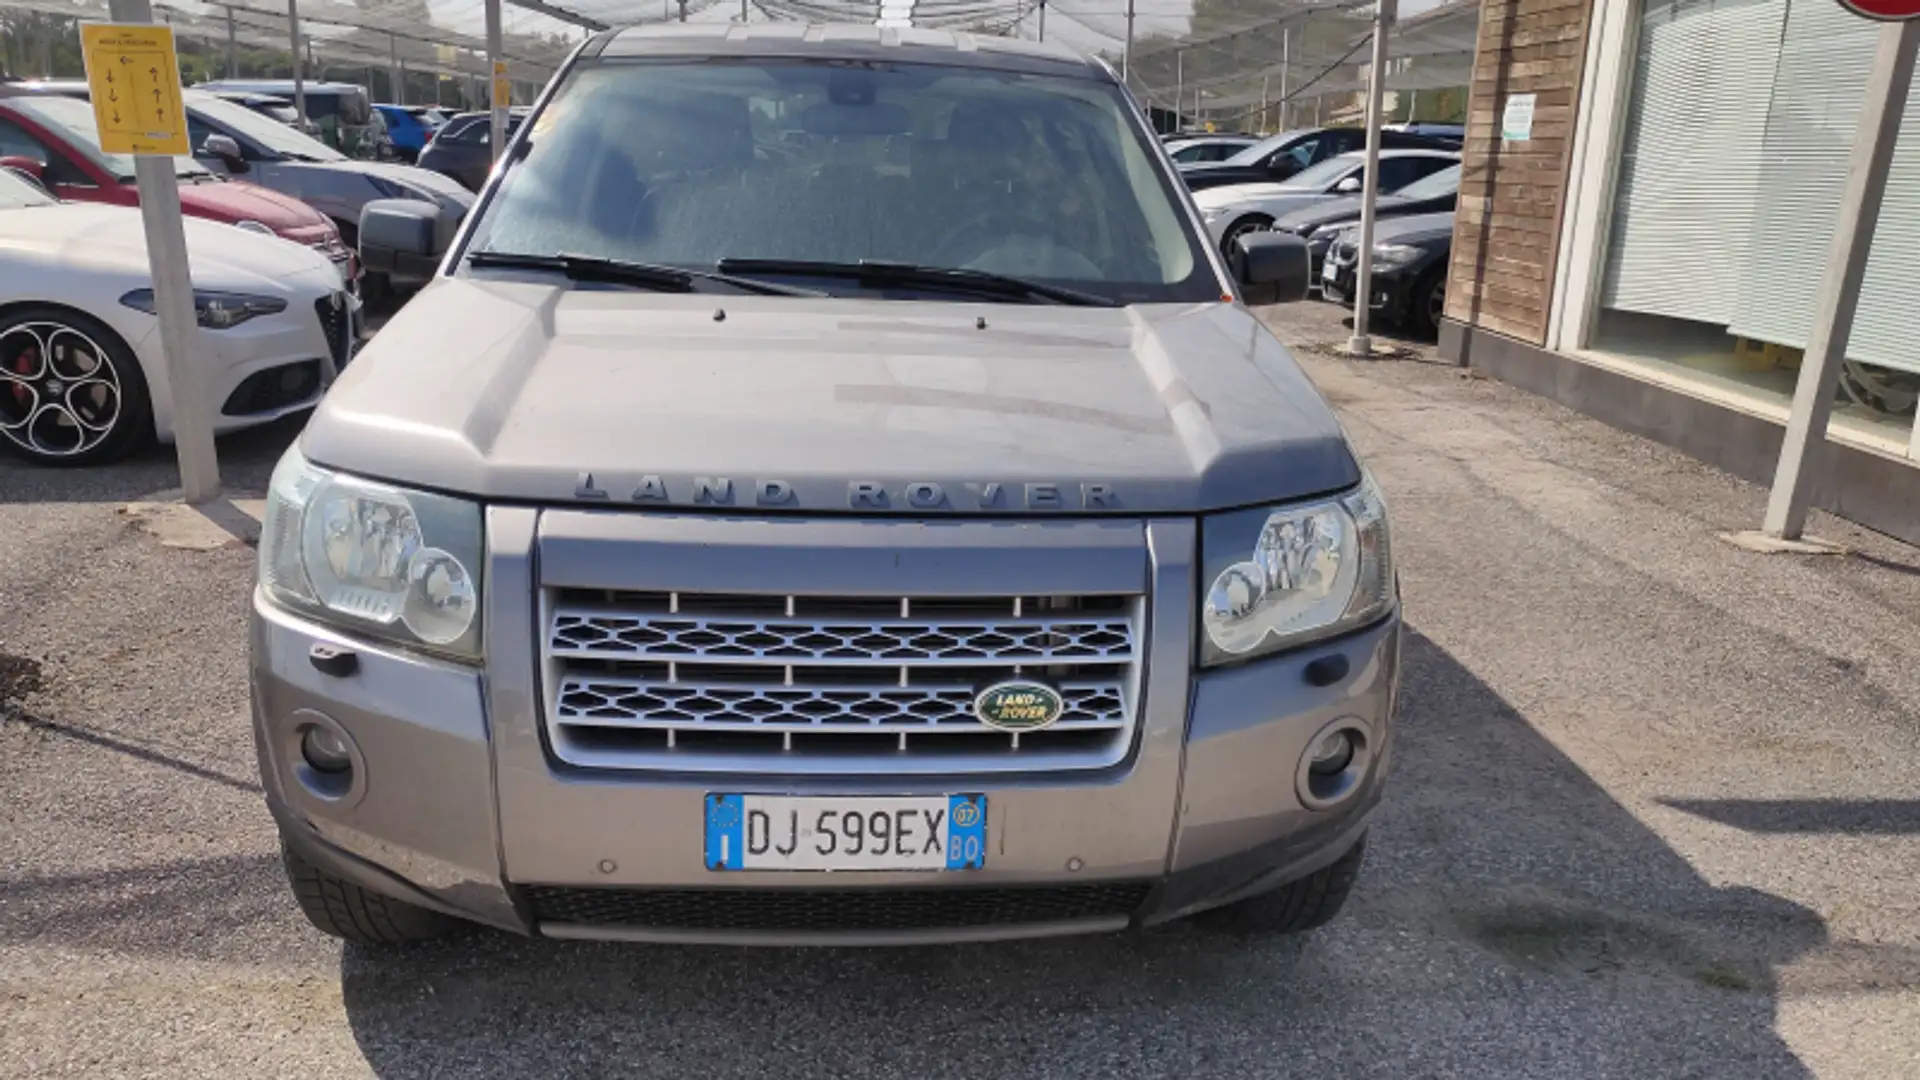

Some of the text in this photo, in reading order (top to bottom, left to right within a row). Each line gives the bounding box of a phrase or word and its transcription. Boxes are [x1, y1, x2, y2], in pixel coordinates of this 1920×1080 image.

[574, 471, 1120, 511] LAND ROVER
[956, 806, 974, 823] 07
[950, 835, 979, 861] BO
